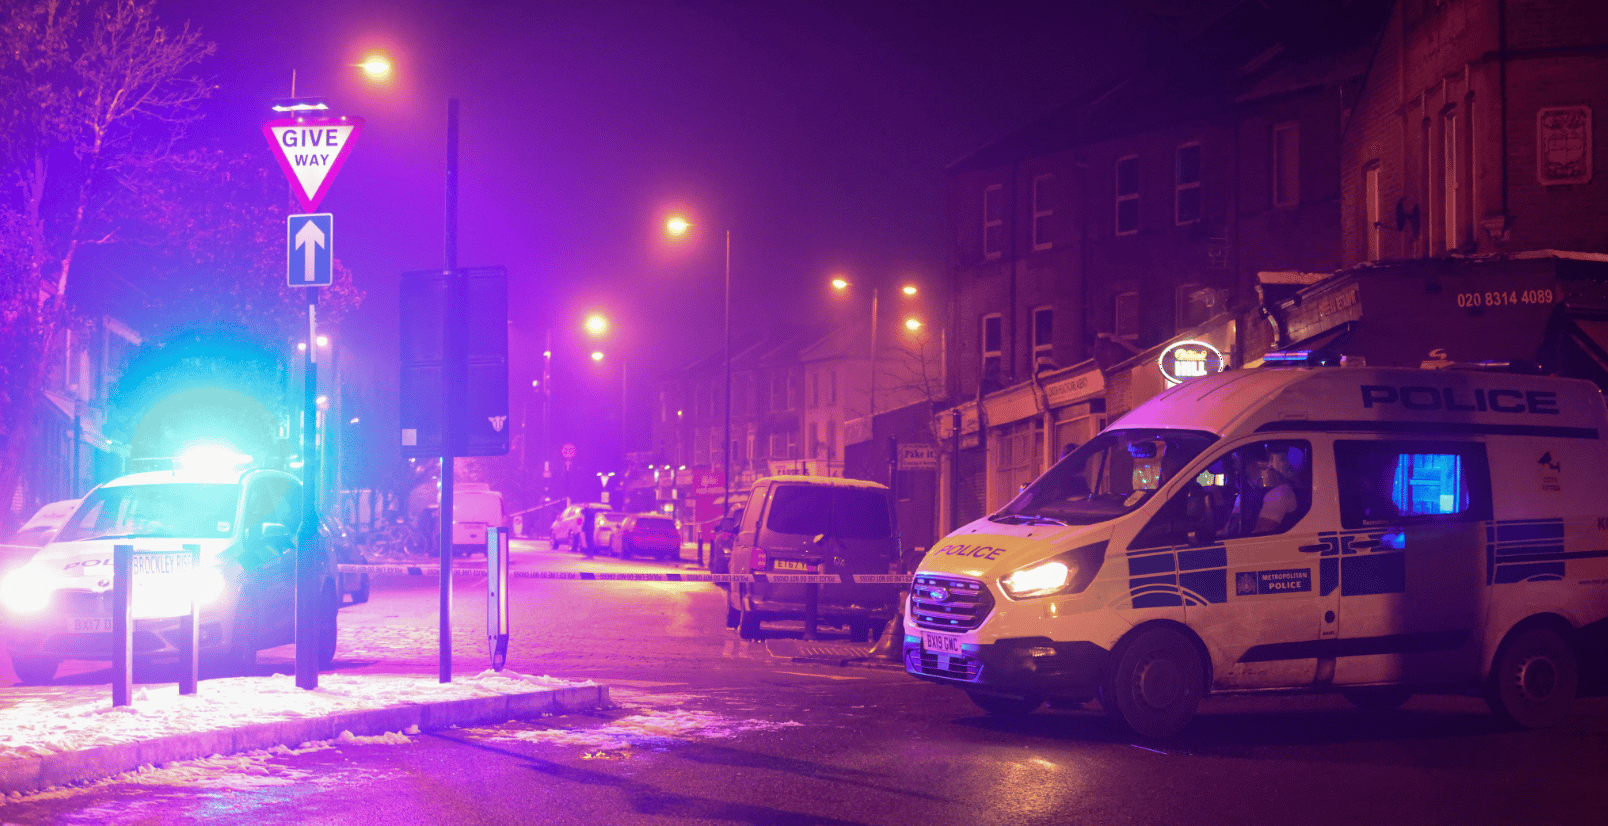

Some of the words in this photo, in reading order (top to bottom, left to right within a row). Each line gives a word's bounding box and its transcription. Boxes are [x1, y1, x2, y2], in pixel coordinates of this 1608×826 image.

[282, 129, 338, 147] GIVE
[294, 154, 329, 166] WAY
[1457, 292, 1481, 307] 020
[1485, 290, 1518, 306] 8314
[1521, 289, 1553, 305] 4089
[1174, 361, 1207, 377] HILL
[1360, 384, 1559, 415] POLICE
[934, 544, 1007, 561] POLICE
[63, 558, 114, 570] POL
[133, 555, 174, 574] BROCKLEY
[1261, 572, 1308, 581] METROPOLITAN
[1268, 581, 1302, 590] POLICE
[74, 618, 100, 631] BX17
[927, 635, 943, 649] BX19
